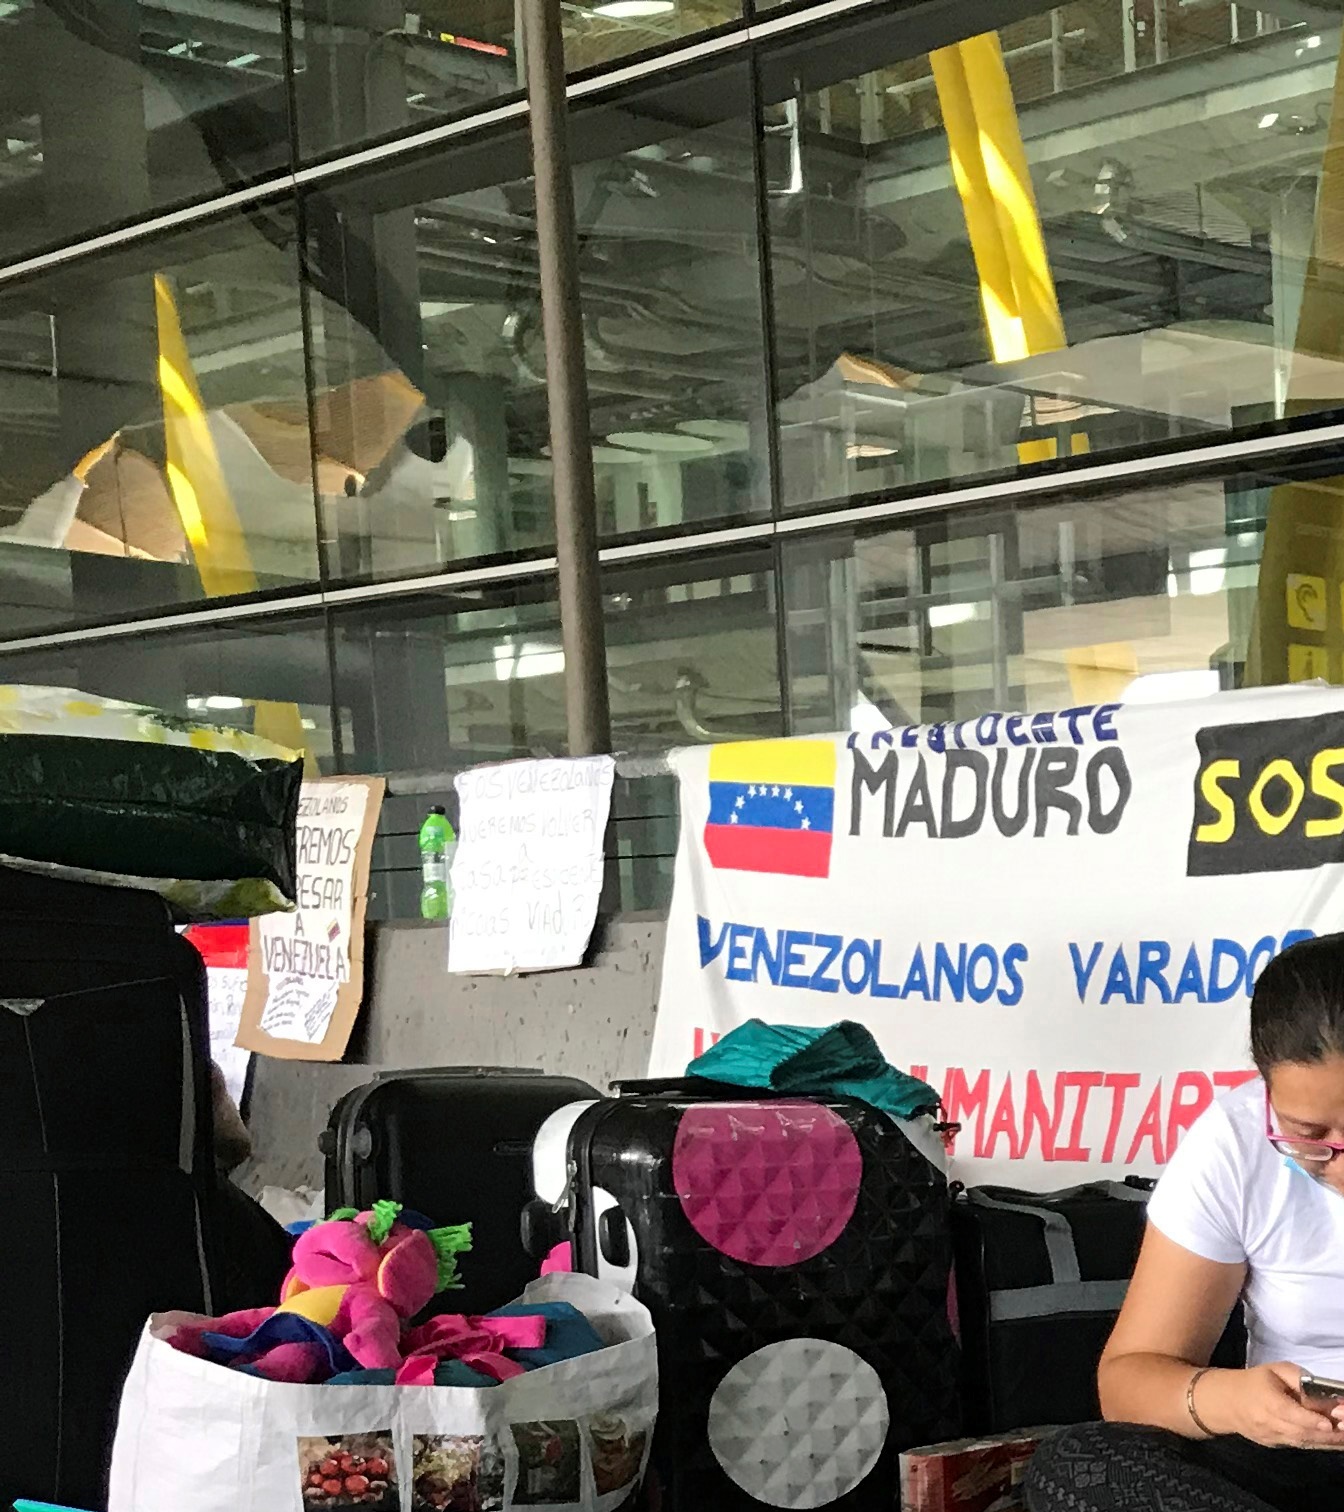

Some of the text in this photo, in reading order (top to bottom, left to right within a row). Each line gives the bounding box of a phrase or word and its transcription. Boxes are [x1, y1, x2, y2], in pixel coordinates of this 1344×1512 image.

[849, 746, 1132, 838] MADURO
[263, 934, 347, 981] VENEZUELA
[697, 914, 1317, 1006] VENEZOLANOS VARADO
